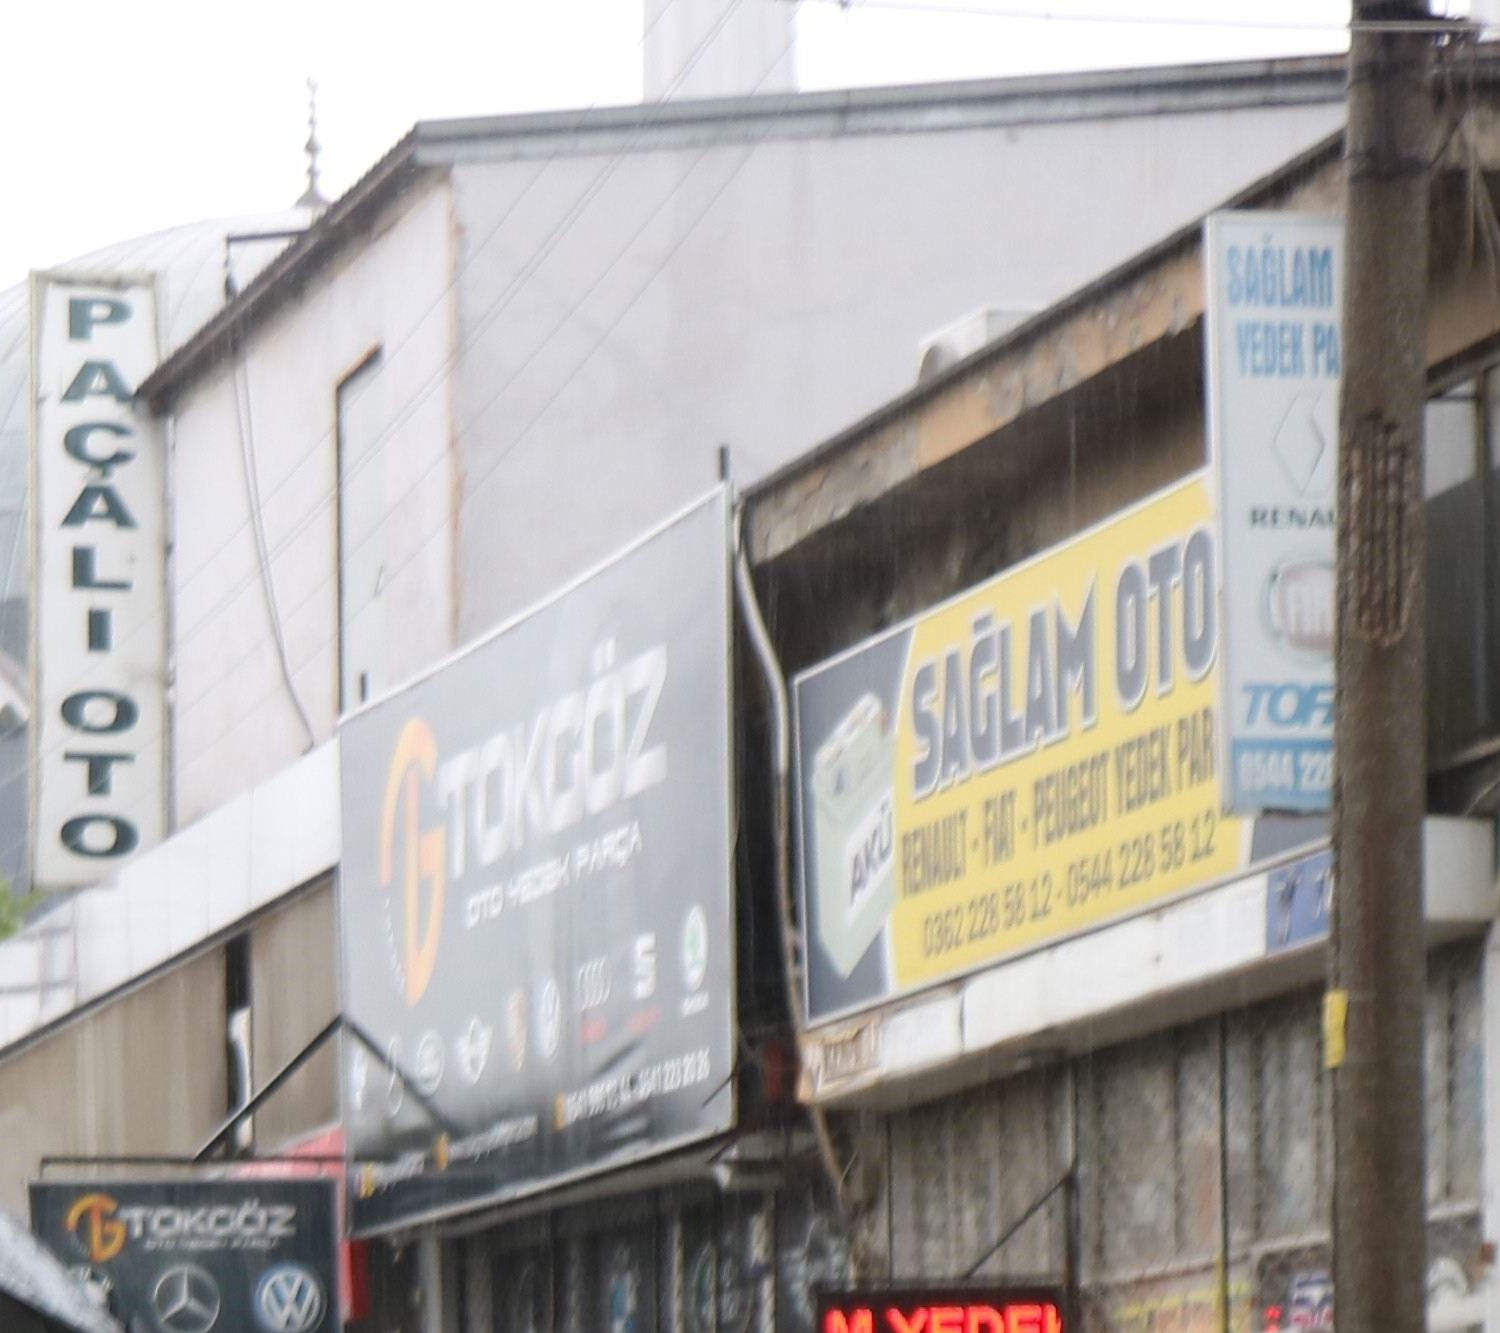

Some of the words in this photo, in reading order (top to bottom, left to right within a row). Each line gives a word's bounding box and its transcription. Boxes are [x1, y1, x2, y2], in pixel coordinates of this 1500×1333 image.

[1225, 233, 1333, 308] SAĞLAM
[1235, 320, 1304, 378] YEDEK
[58, 297, 139, 653] PAÇALI
[911, 570, 1098, 800] SAĞLAM
[1115, 527, 1219, 712] OTO
[58, 690, 140, 861] OTO
[900, 804, 968, 899] RENAULT
